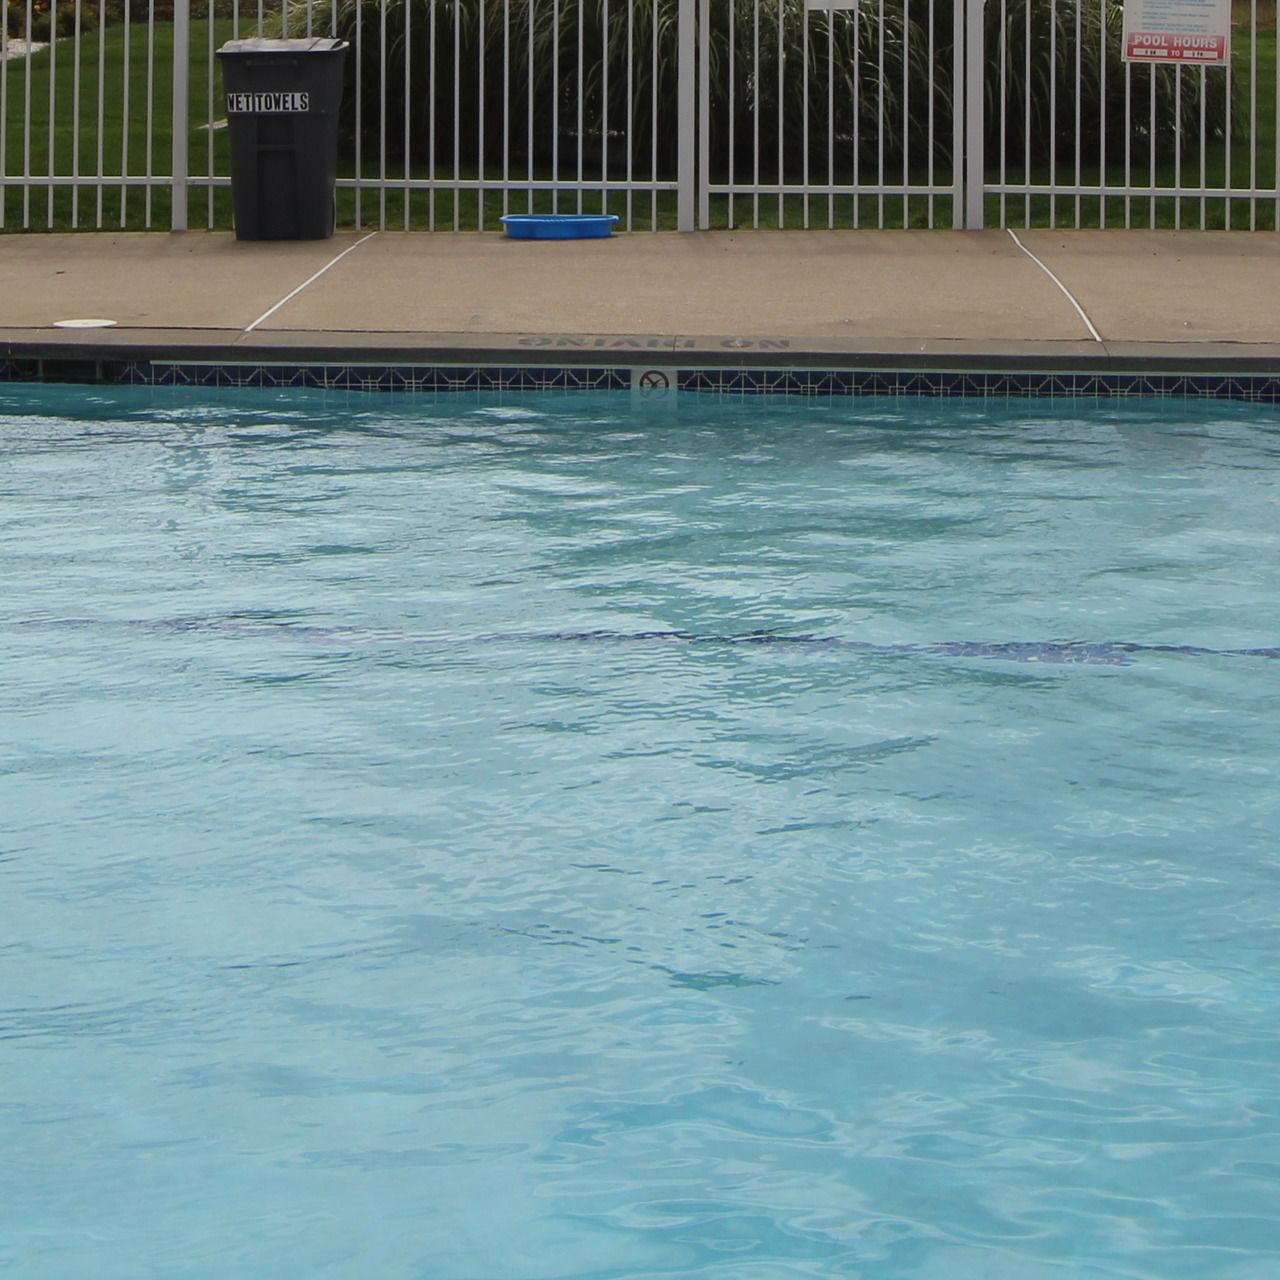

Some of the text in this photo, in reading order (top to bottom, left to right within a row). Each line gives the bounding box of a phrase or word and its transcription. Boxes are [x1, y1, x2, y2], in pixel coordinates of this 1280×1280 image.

[1133, 35, 1217, 49] POOL HOURS
[228, 94, 308, 111] WET TOWELS
[517, 337, 791, 349] NO DIVING
